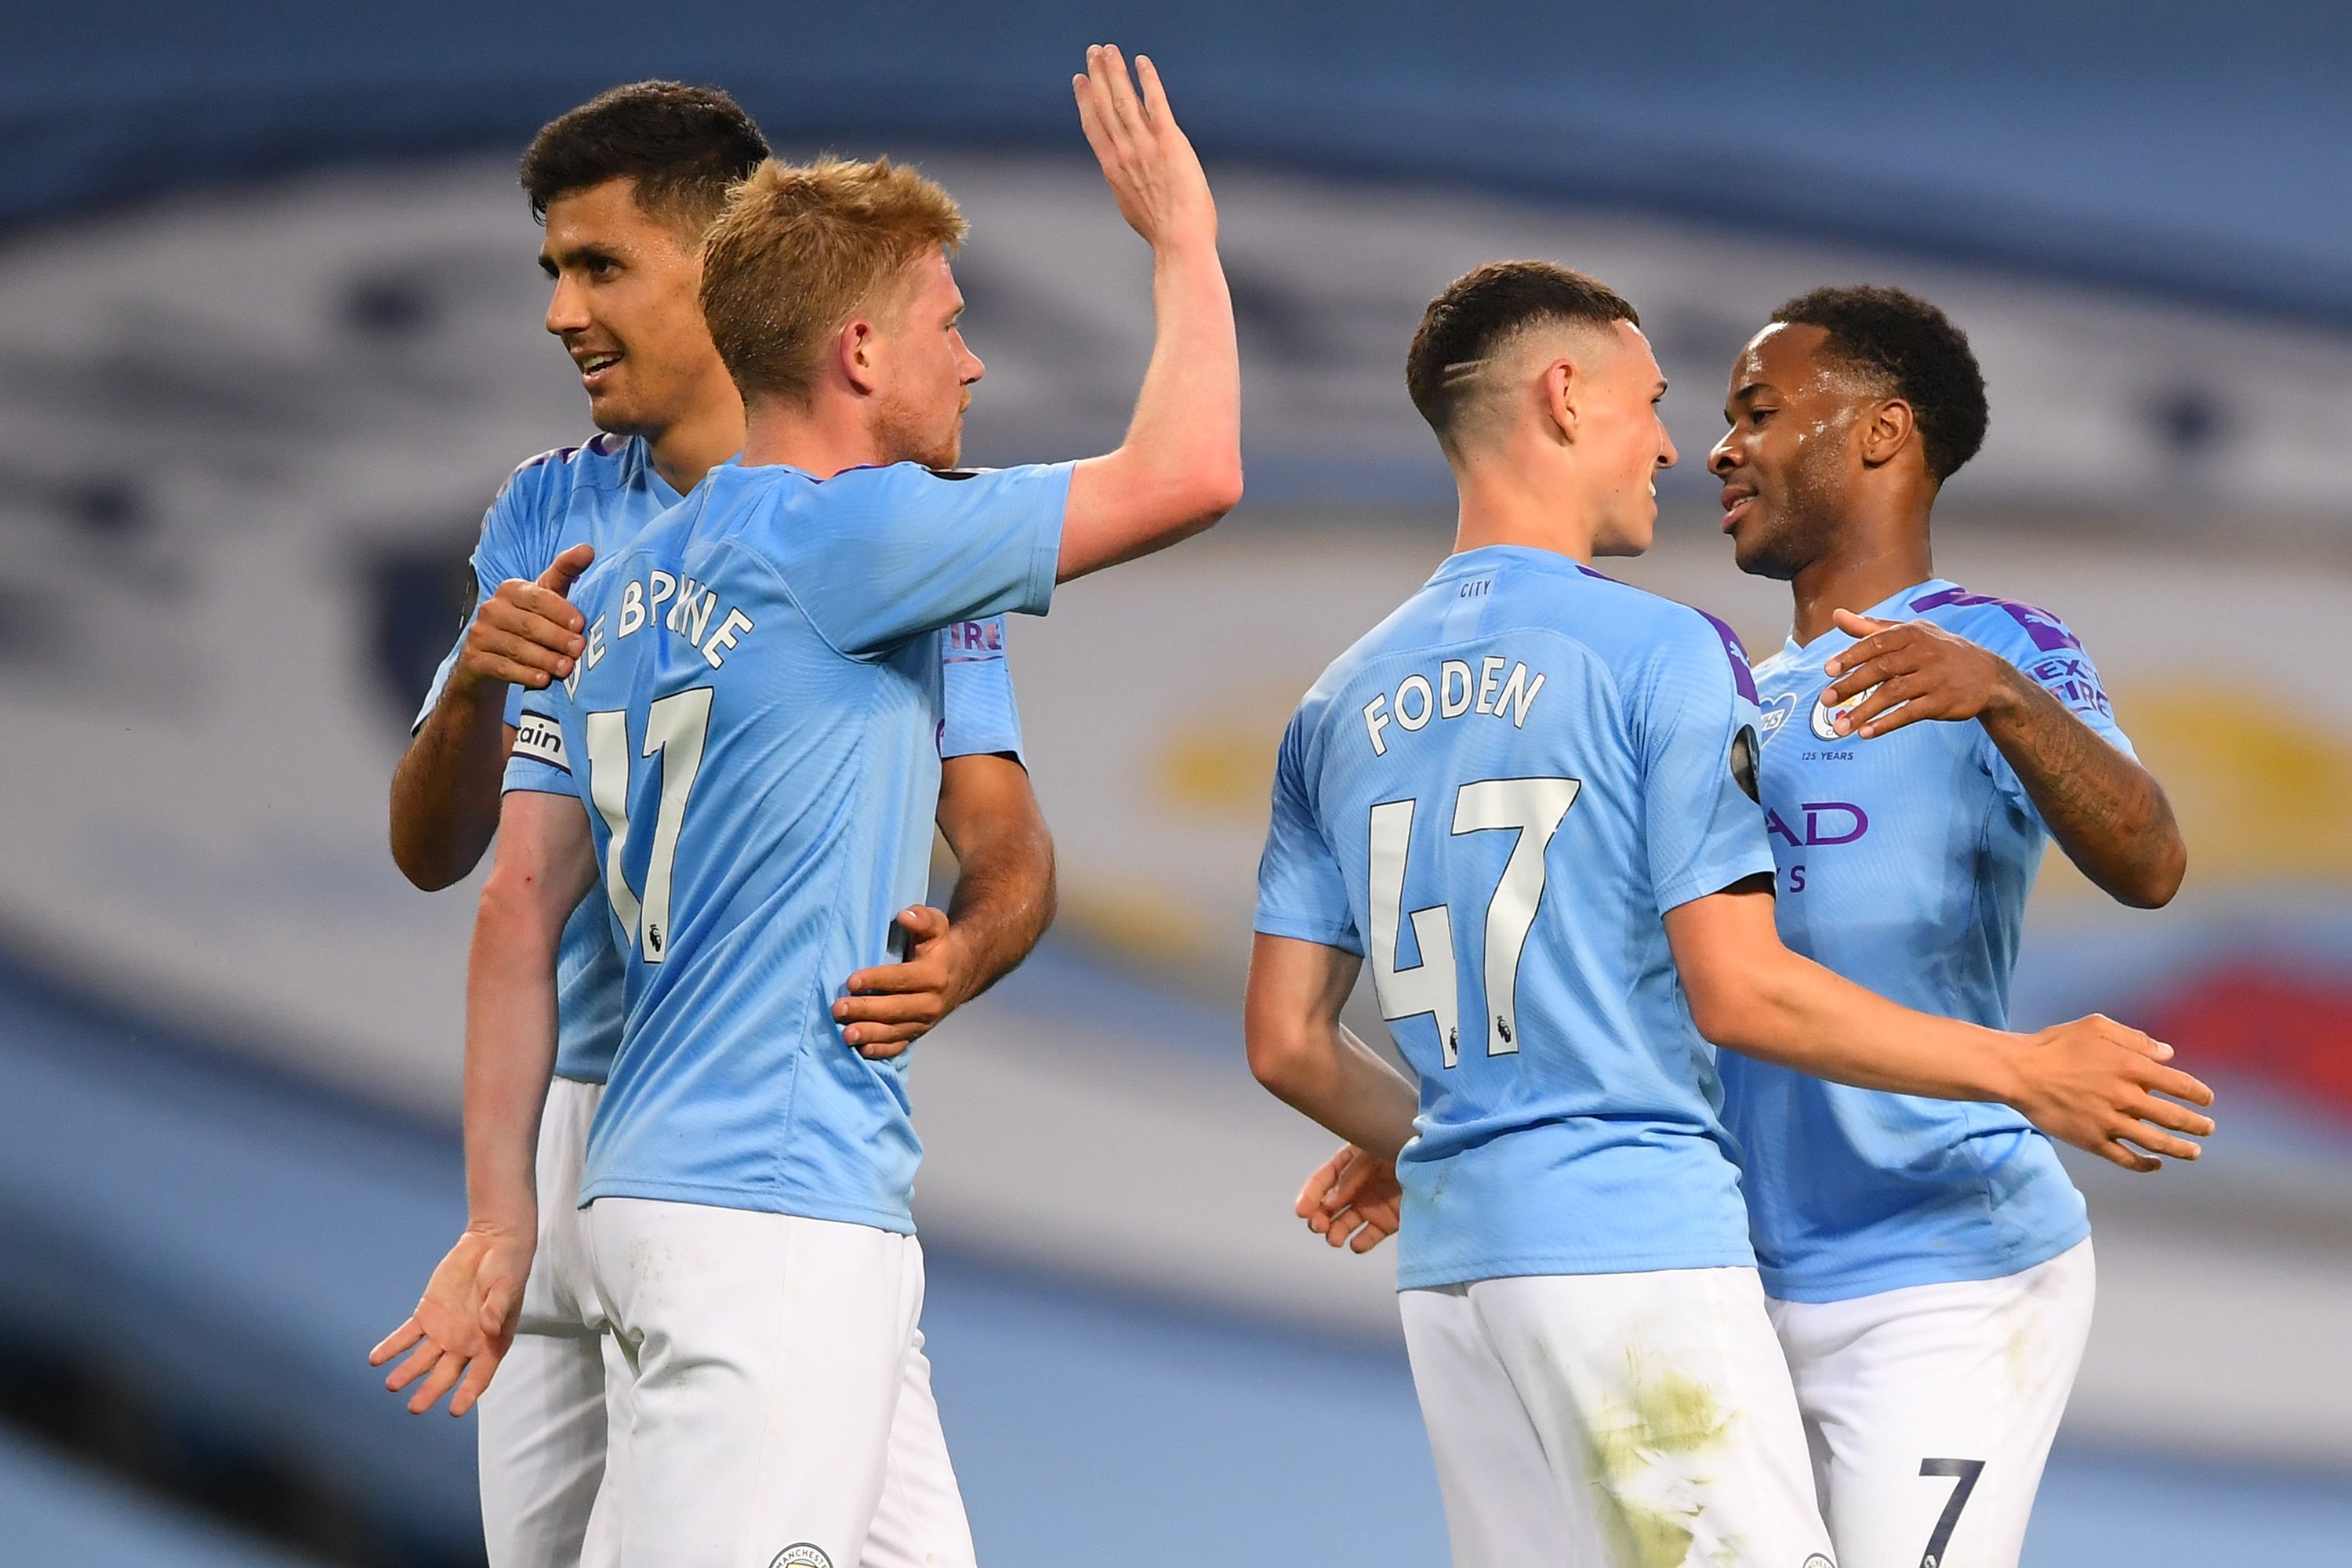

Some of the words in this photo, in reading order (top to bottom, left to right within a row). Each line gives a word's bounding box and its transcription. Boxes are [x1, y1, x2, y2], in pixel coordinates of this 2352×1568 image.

[1460, 579, 1491, 598] CITY
[950, 622, 1002, 652] IRE
[516, 723, 561, 753] ain
[1363, 656, 1545, 757] FODEN
[1802, 752, 1817, 760] 125
[1820, 752, 1854, 760] YEARS
[586, 685, 714, 964] 17
[1368, 777, 1581, 1069] 47
[1918, 1458, 1986, 1568] 7
